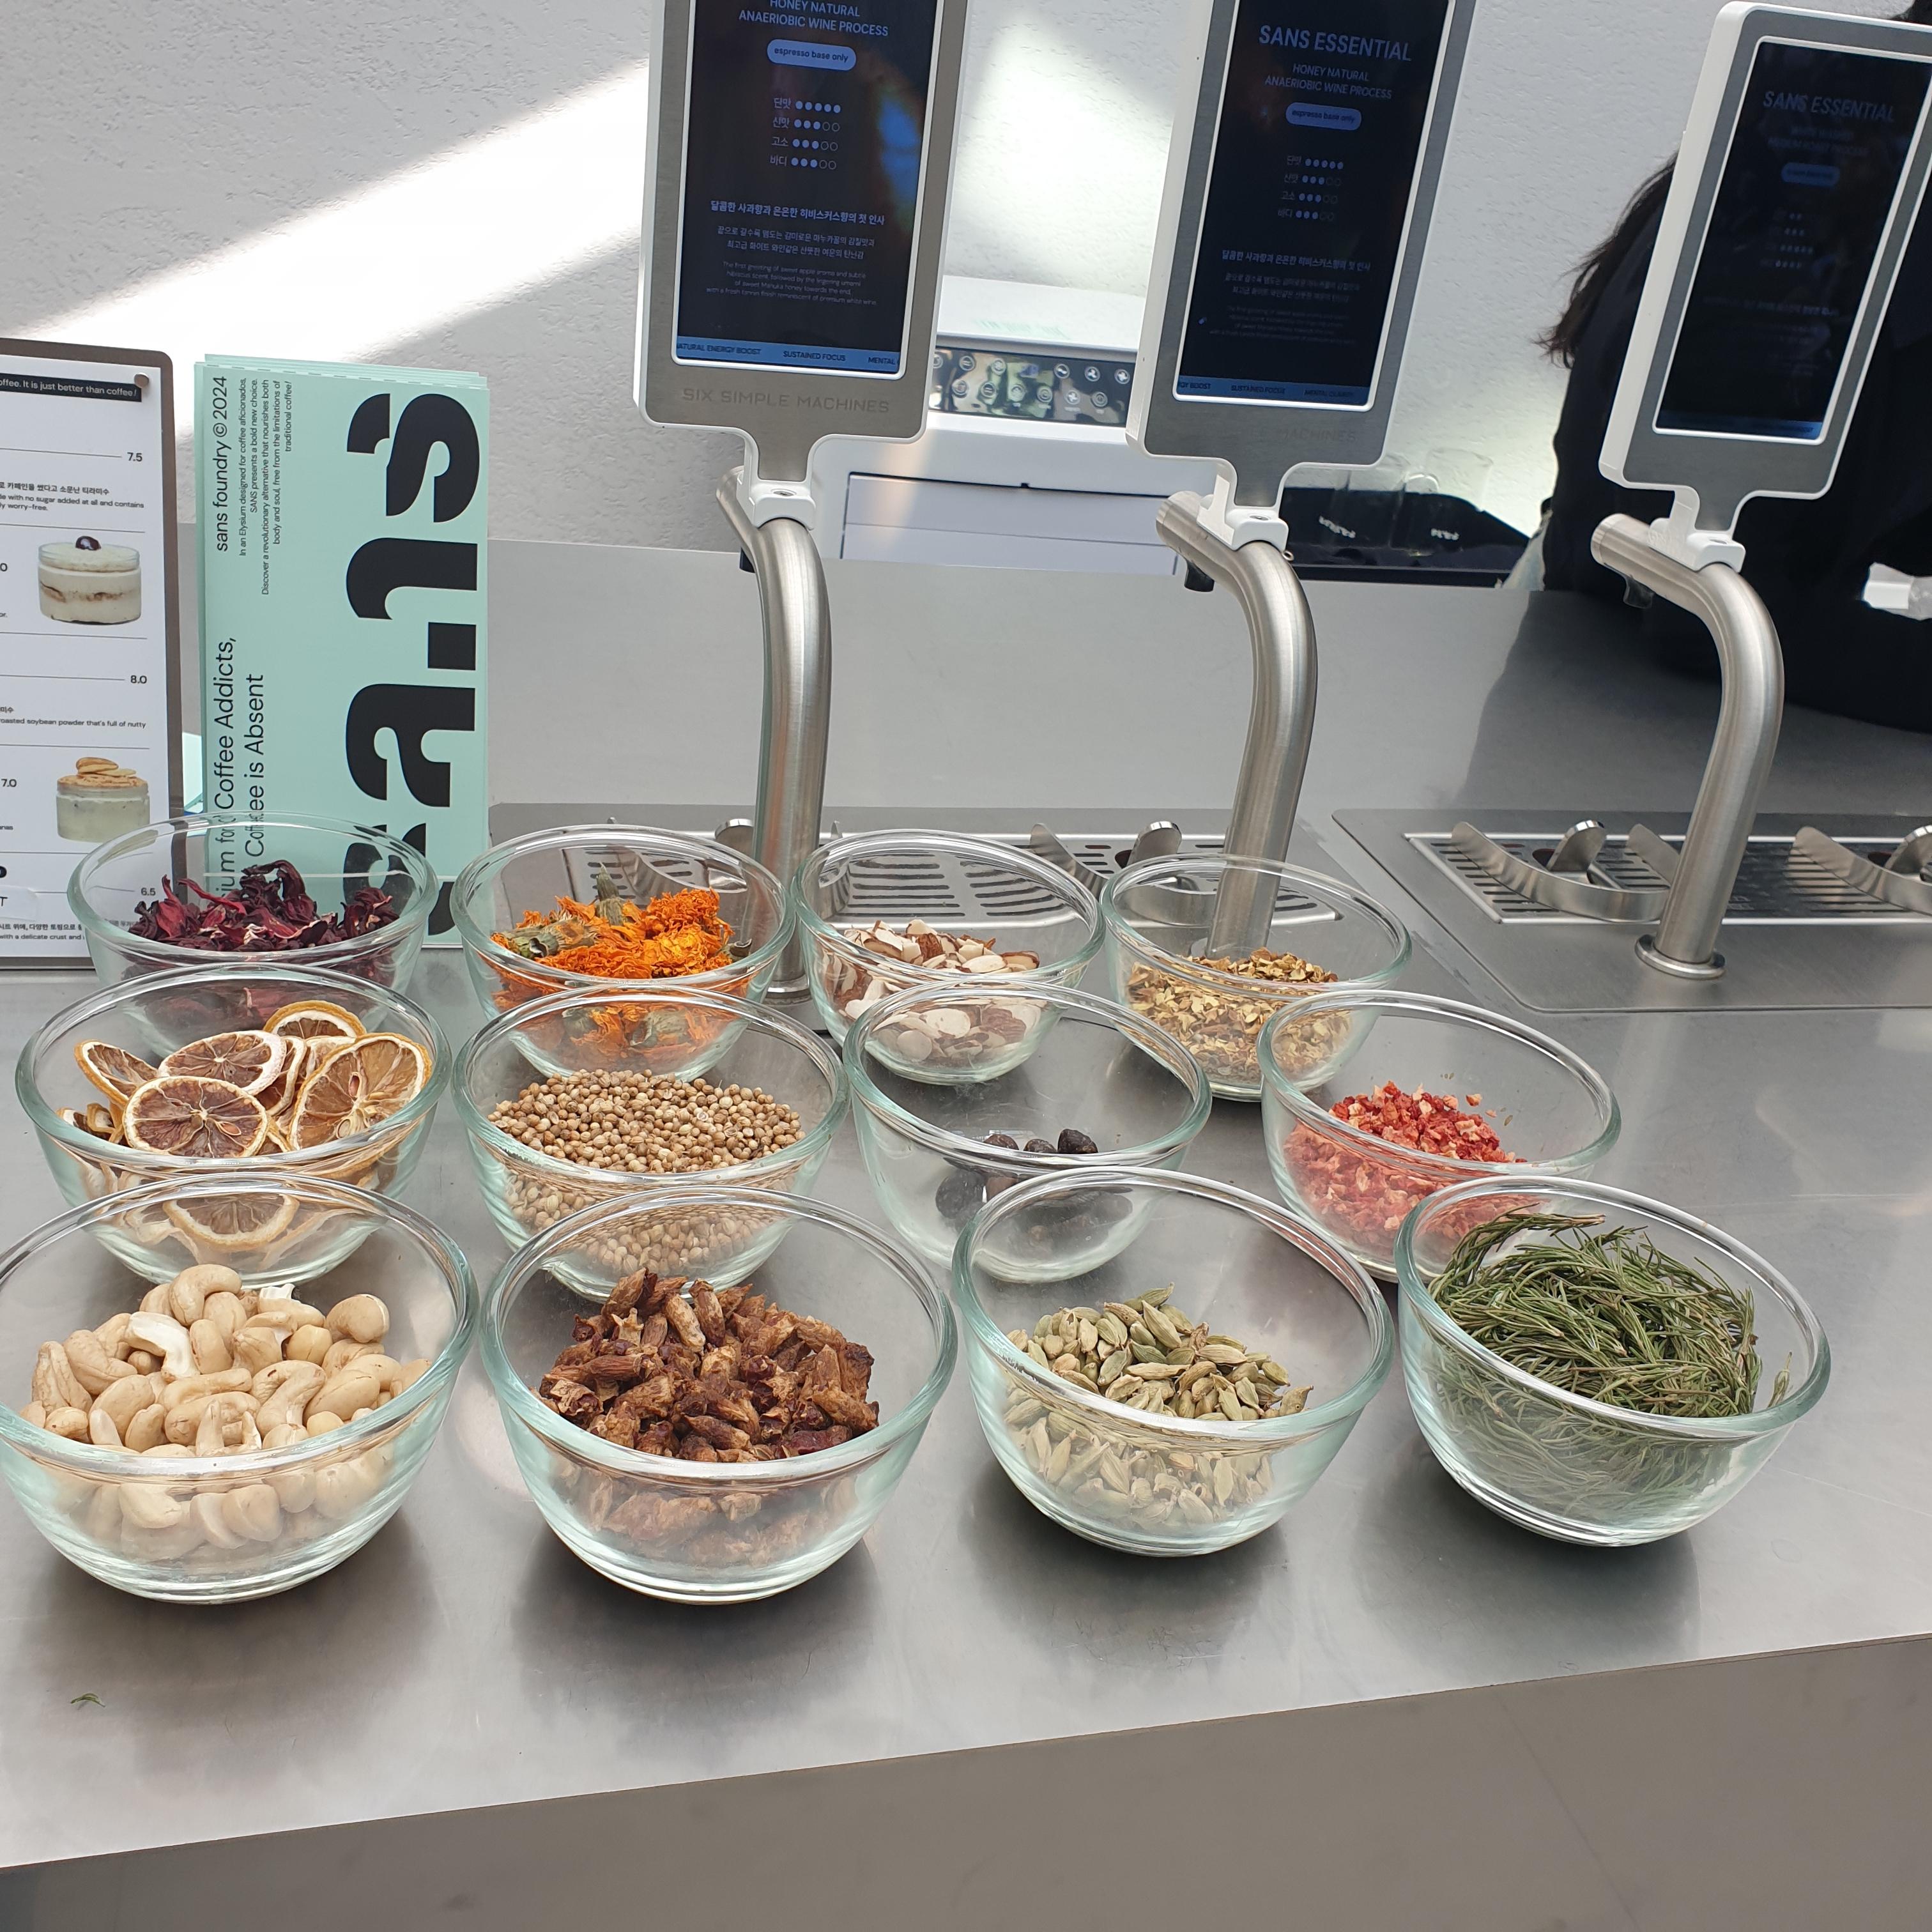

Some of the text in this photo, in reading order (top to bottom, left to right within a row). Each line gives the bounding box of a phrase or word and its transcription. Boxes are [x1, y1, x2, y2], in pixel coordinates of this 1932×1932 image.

[770, 0, 860, 17] HONEY NATURAL
[739, 10, 889, 36] ANAERIOBIC WINE PROCESS
[1259, 25, 1413, 62] SANS ESSENTIAL
[774, 47, 848, 63] espresso base only
[1292, 63, 1370, 82] HONEY NATURAL
[1265, 75, 1393, 100] ANAERIOBIC WINE PROCESS
[1763, 91, 1896, 123] SANS ESSENTIAL
[772, 116, 790, 128] 신맛
[771, 136, 789, 147] 고소
[769, 155, 787, 167] 바디
[710, 200, 885, 226] 달콤한 사과향과 은은한 히비스커스향의 첫 인사
[677, 343, 705, 351] ATURAL
[736, 346, 762, 355] BOOST
[783, 350, 846, 362] SUSTAINED FOCUS
[868, 356, 896, 365] MENTAL
[31, 380, 38, 389] is
[40, 381, 56, 391] just
[57, 383, 84, 393] better
[86, 385, 105, 394] than
[106, 387, 137, 397] coffee!
[261, 379, 269, 399] both
[682, 388, 890, 414] SIX SIMPLE MACHINES
[261, 400, 269, 440] nourishes
[284, 381, 292, 452] traditional coffee!
[126, 452, 143, 462] 7.5
[261, 441, 269, 458] that
[212, 376, 231, 552] sans foundry 2024
[250, 454, 259, 490] presents
[272, 380, 282, 545] body and soul, free from the limitations of
[82, 487, 110, 496] 티라미수
[238, 467, 248, 505] designed
[261, 459, 269, 502] alternative
[239, 505, 248, 536] Elysium
[261, 502, 270, 553] revolutionary
[240, 537, 247, 548] an
[261, 562, 269, 595] Discover
[130, 675, 148, 684] 8.0
[213, 637, 236, 729] Addicts,
[27, 718, 57, 727] soybean
[243, 674, 264, 756] Absent
[213, 735, 234, 809] Coffee
[243, 762, 264, 779] is
[2, 778, 17, 788] 7.0
[244, 785, 264, 857] Coffee
[141, 887, 156, 896] 6.5
